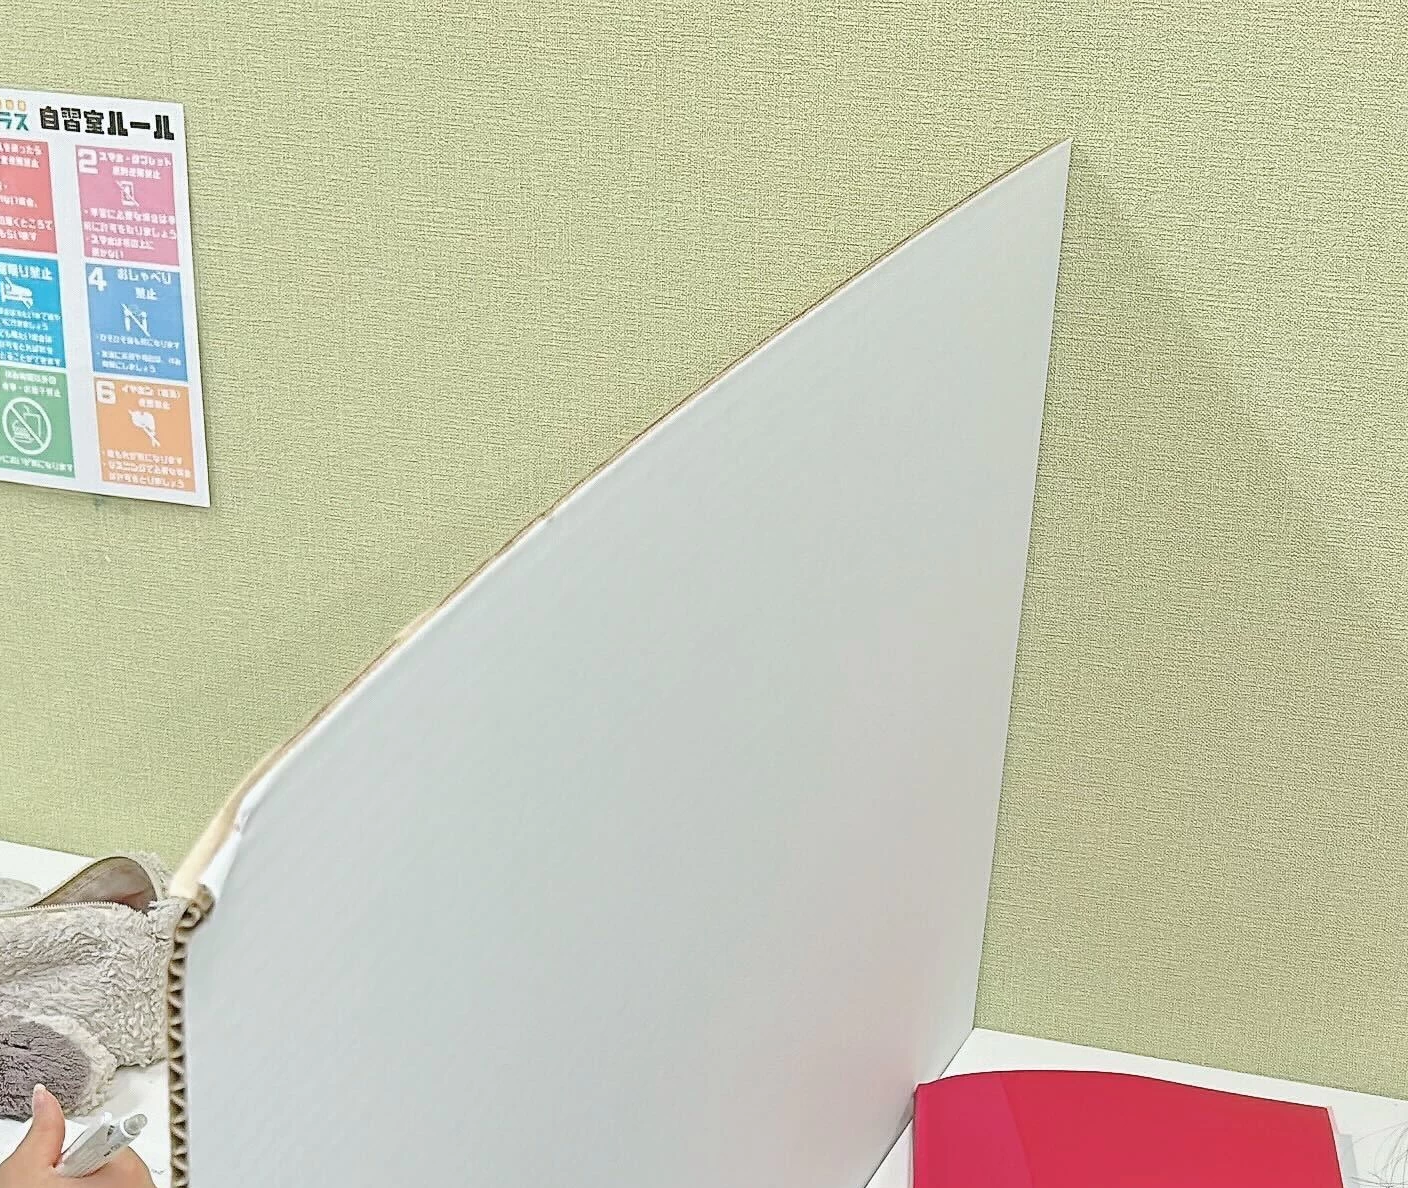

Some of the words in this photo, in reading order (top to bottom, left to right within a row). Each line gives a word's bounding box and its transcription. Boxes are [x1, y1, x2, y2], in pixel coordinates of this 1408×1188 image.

[39, 105, 175, 140] 自習室ルール
[77, 148, 98, 174] 2
[88, 266, 108, 291] 4
[117, 268, 171, 284] おしゃべり
[95, 380, 116, 404] 6
